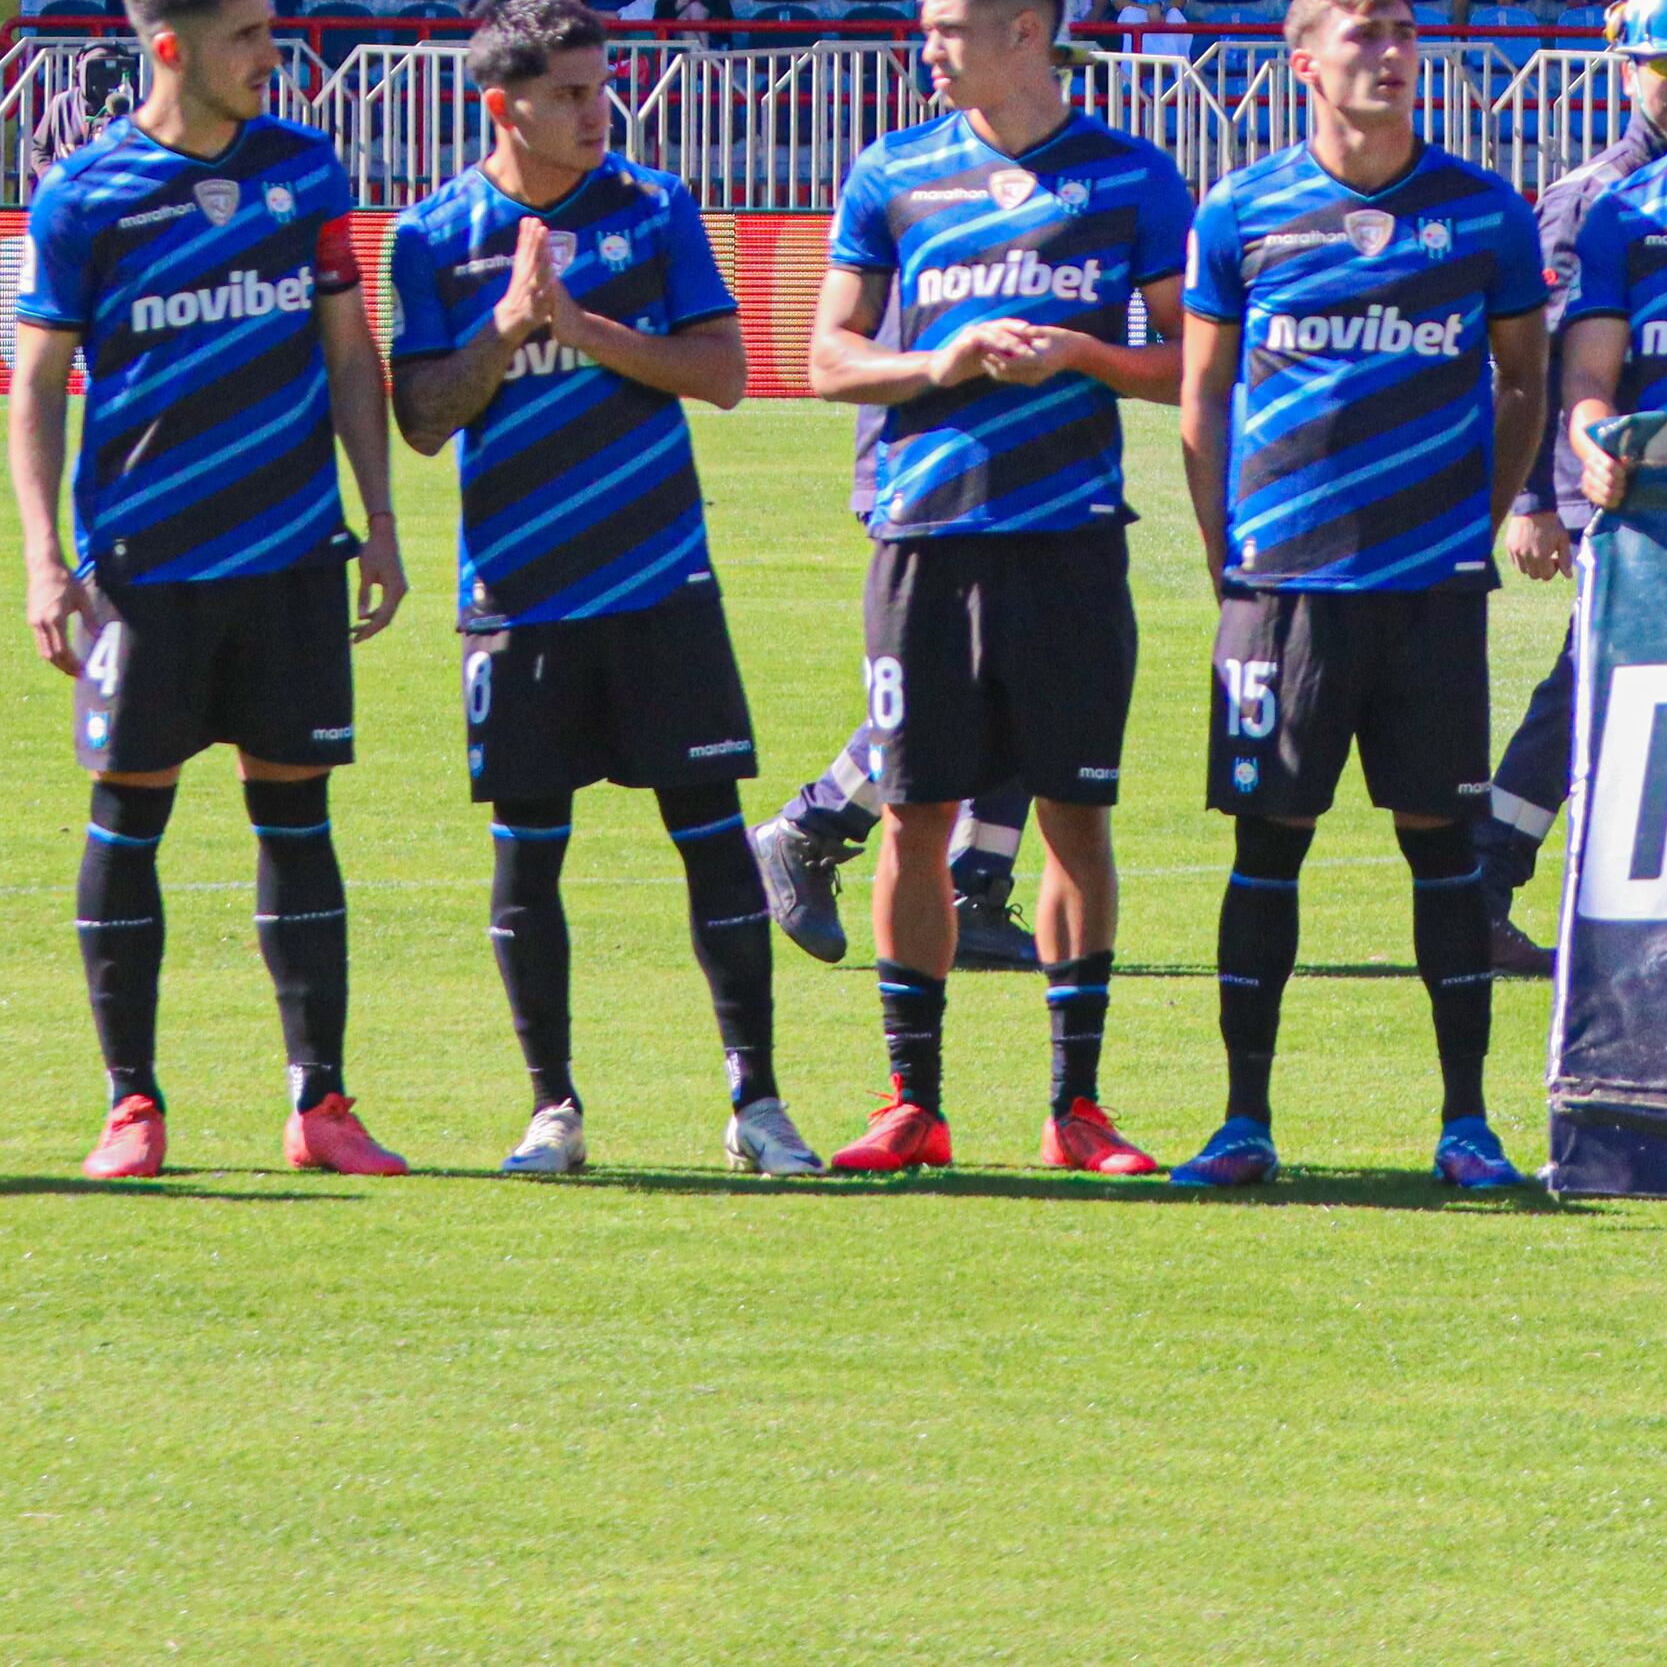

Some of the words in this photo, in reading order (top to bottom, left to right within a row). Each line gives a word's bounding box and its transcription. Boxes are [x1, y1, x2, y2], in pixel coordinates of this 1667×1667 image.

[911, 187, 989, 201] marathon
[118, 201, 197, 230] marathon
[1264, 229, 1347, 246] marathon
[918, 249, 1102, 307] novibet
[132, 269, 315, 333] novibet
[1266, 304, 1464, 357] novibet
[1223, 659, 1277, 738] 15
[688, 738, 752, 759] marathon
